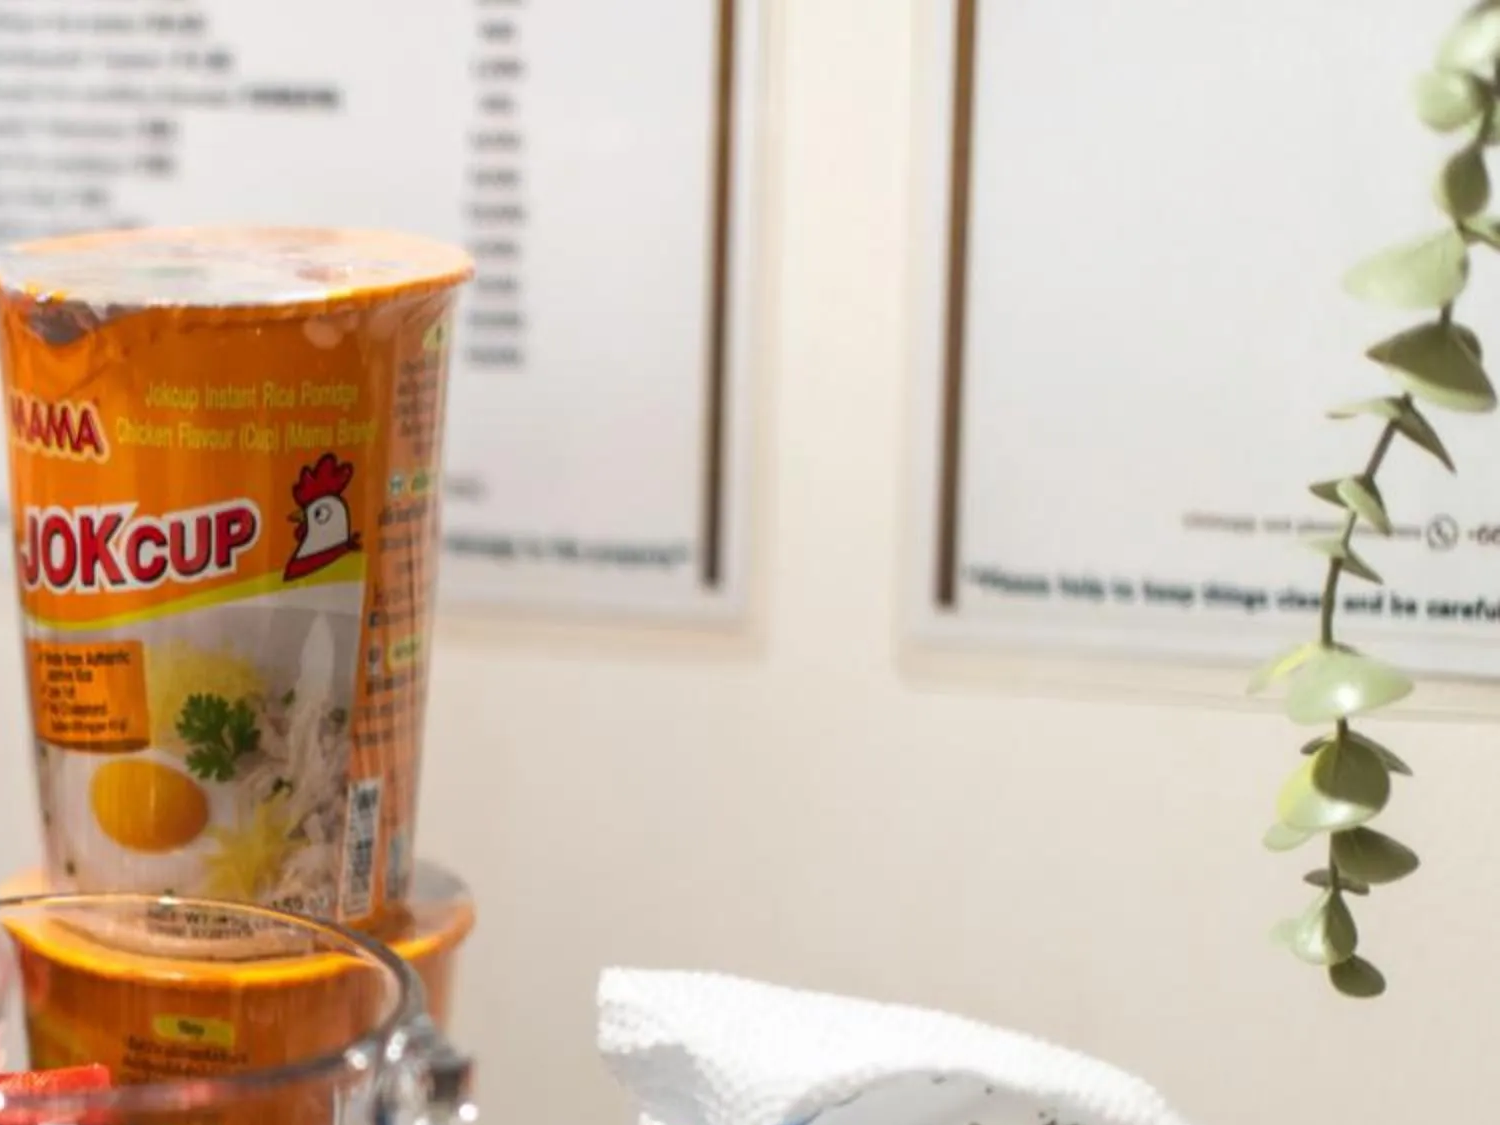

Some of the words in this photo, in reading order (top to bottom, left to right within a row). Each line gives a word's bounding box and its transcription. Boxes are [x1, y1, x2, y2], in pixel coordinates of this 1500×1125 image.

[205, 382, 257, 412] Instant
[263, 380, 296, 410] Rice
[116, 416, 172, 448] Chicken
